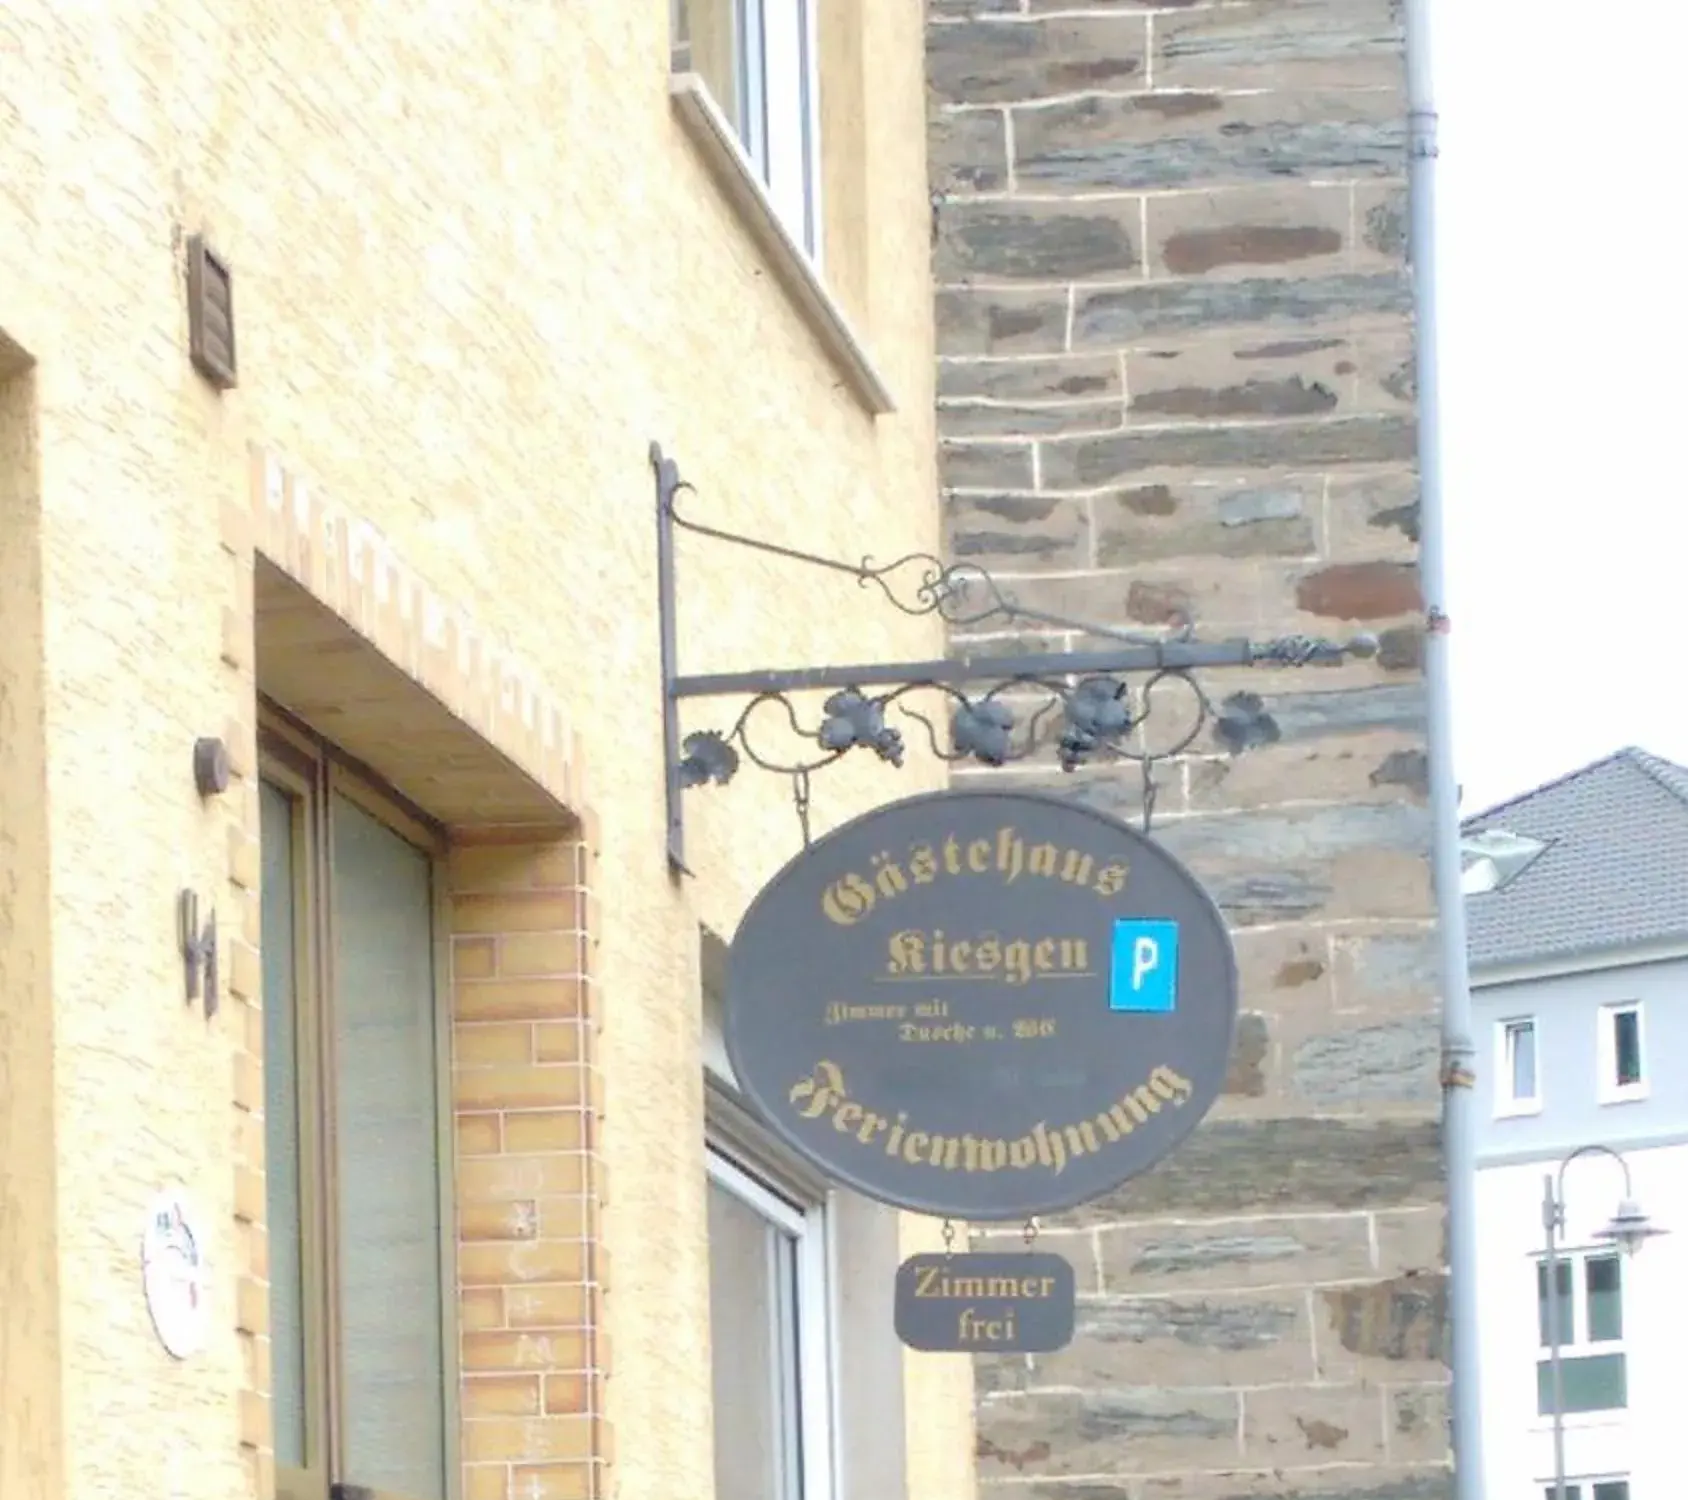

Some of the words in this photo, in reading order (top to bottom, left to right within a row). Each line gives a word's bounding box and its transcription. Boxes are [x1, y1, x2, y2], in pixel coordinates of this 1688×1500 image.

[822, 826, 1131, 926] Gästehaus
[888, 928, 1088, 985] Kiesgen
[1130, 935, 1159, 991] P
[790, 1059, 1193, 1177] Ferienwohnung
[914, 1266, 1055, 1298] Zimmer
[958, 1307, 1016, 1341] frei
